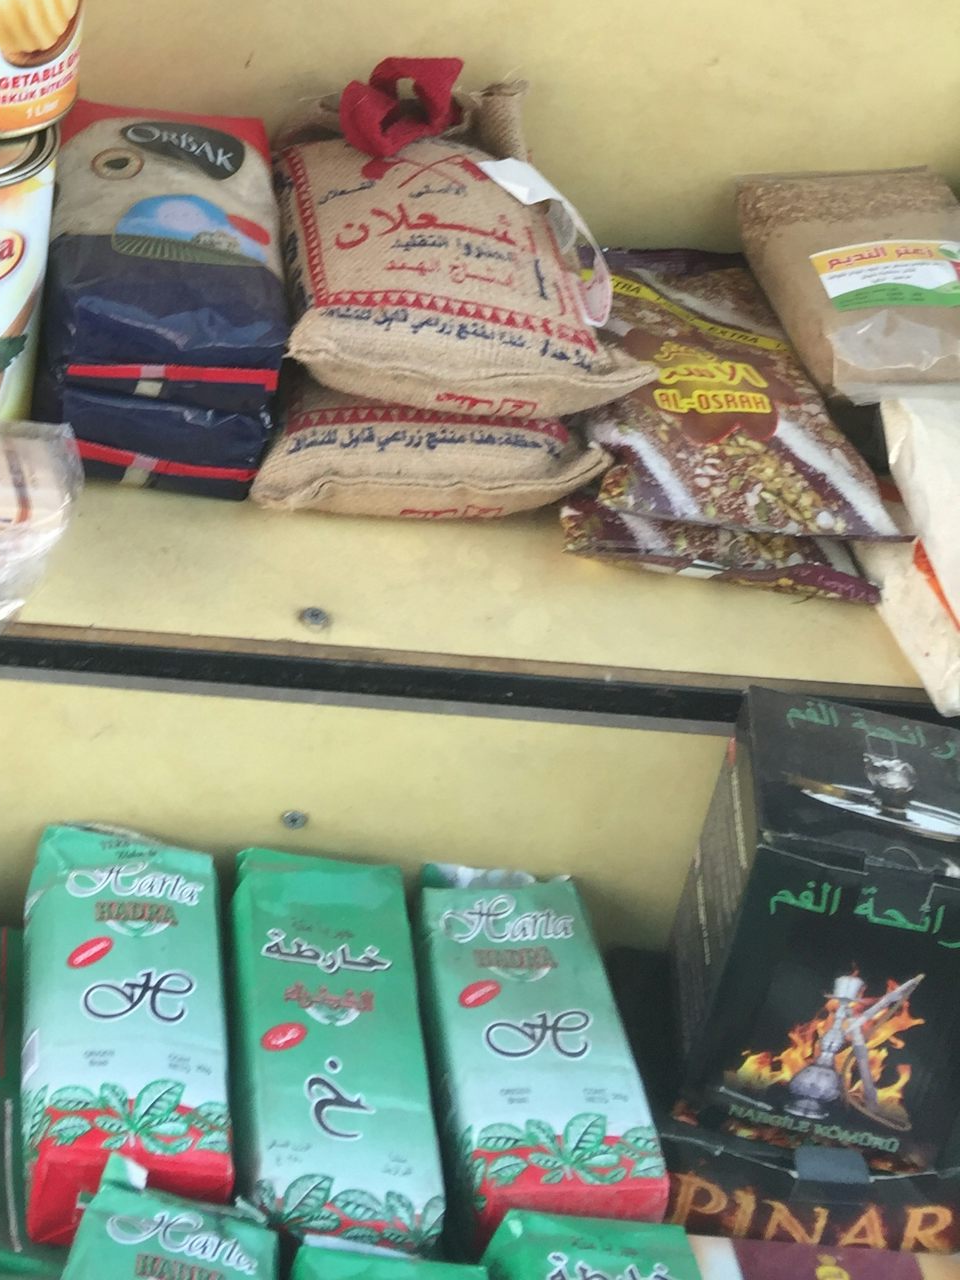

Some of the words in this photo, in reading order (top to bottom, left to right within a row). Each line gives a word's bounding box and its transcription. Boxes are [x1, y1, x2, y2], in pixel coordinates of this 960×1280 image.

[336, 203, 517, 251] شعلان
[708, 325, 759, 345] EXTRA
[65, 861, 205, 907] Harta
[441, 894, 575, 944] Harta
[674, 1172, 957, 1254] PINAR
